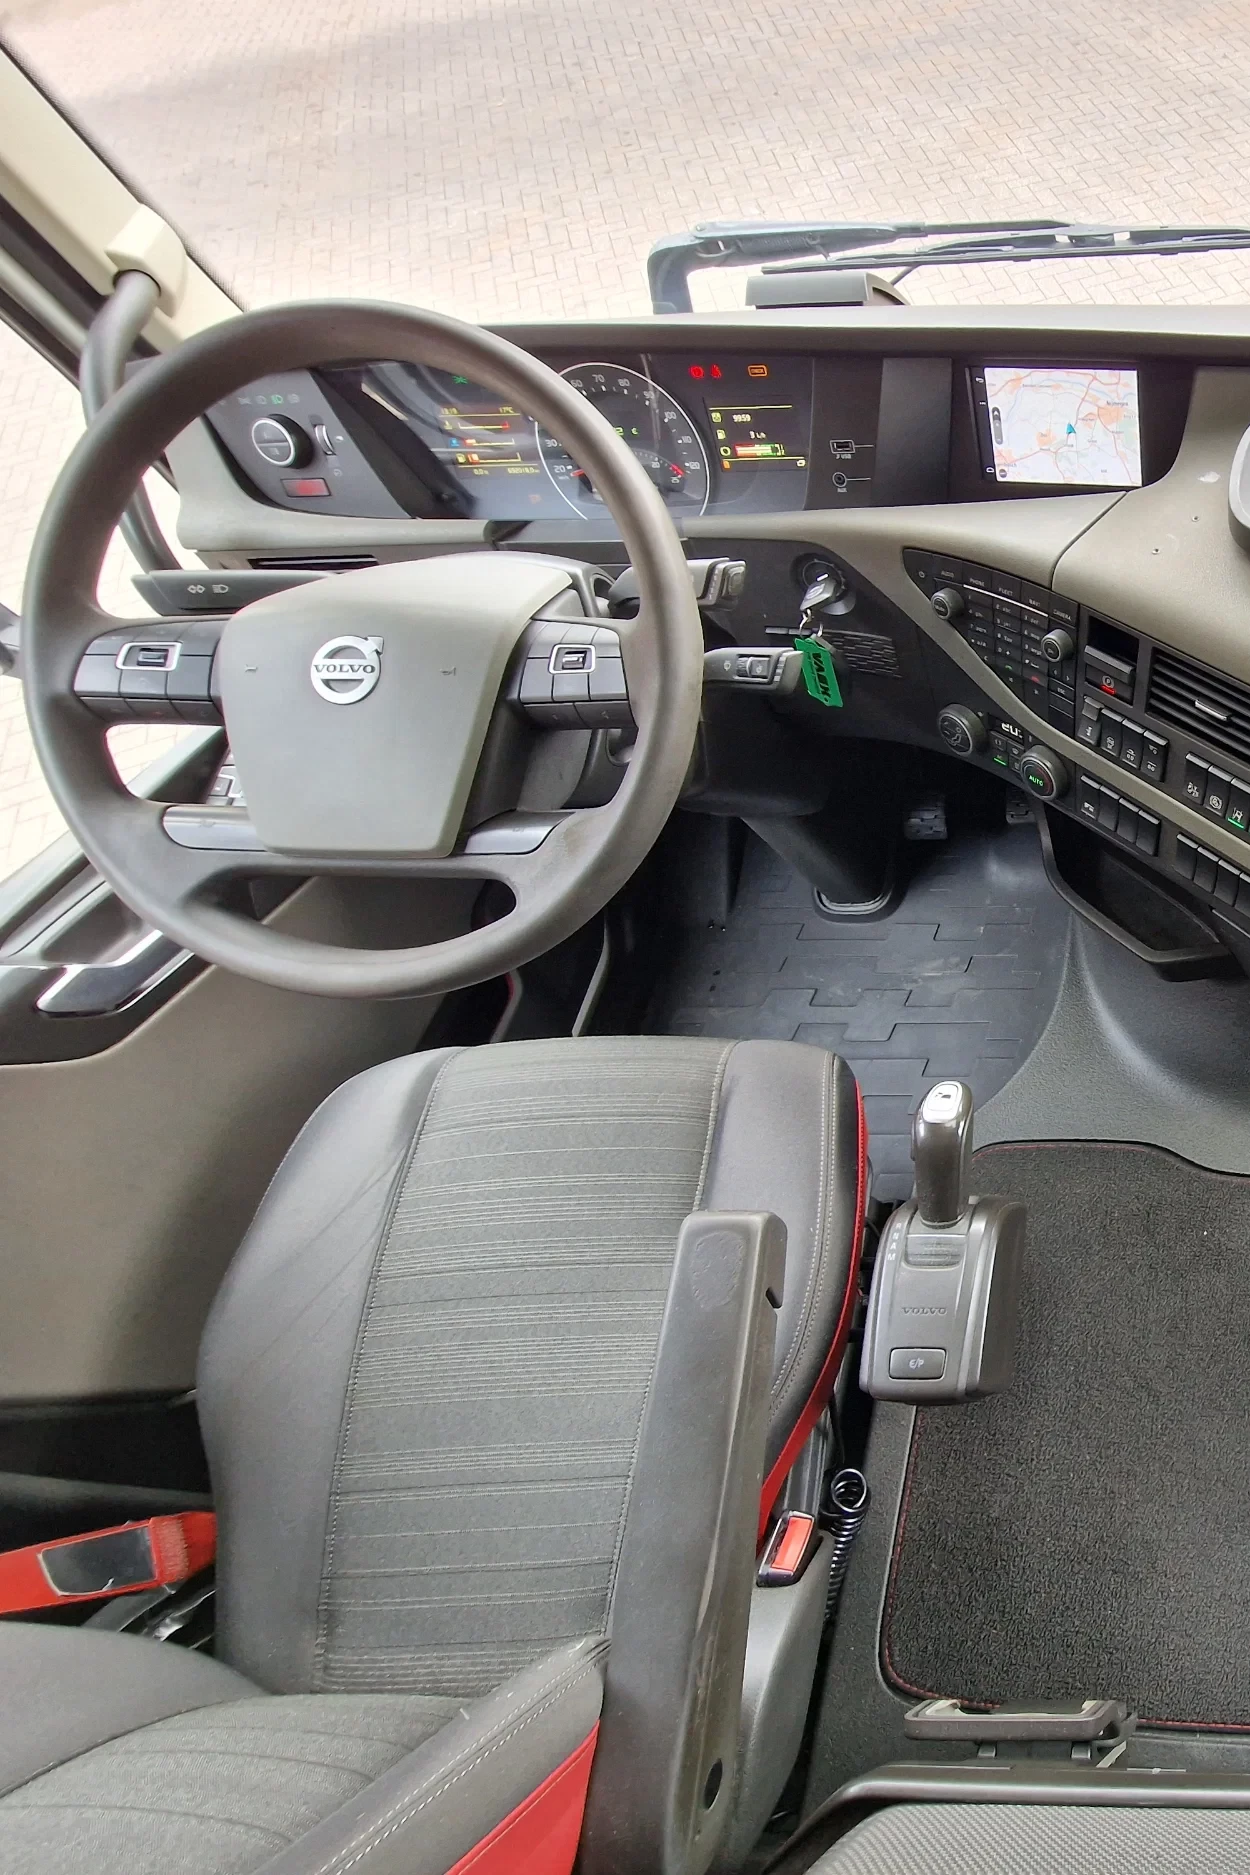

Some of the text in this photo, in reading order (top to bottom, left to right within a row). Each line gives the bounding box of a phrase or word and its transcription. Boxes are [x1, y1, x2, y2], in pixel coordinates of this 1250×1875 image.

[592, 374, 604, 383] 70
[618, 379, 630, 387] 80
[545, 439, 558, 447] 30
[554, 465, 566, 473] 20
[314, 664, 376, 674] VOLVO
[1028, 775, 1044, 786] AUTO
[890, 1242, 897, 1250] A
[887, 1252, 896, 1261] M
[901, 1307, 947, 1315] VOLVO
